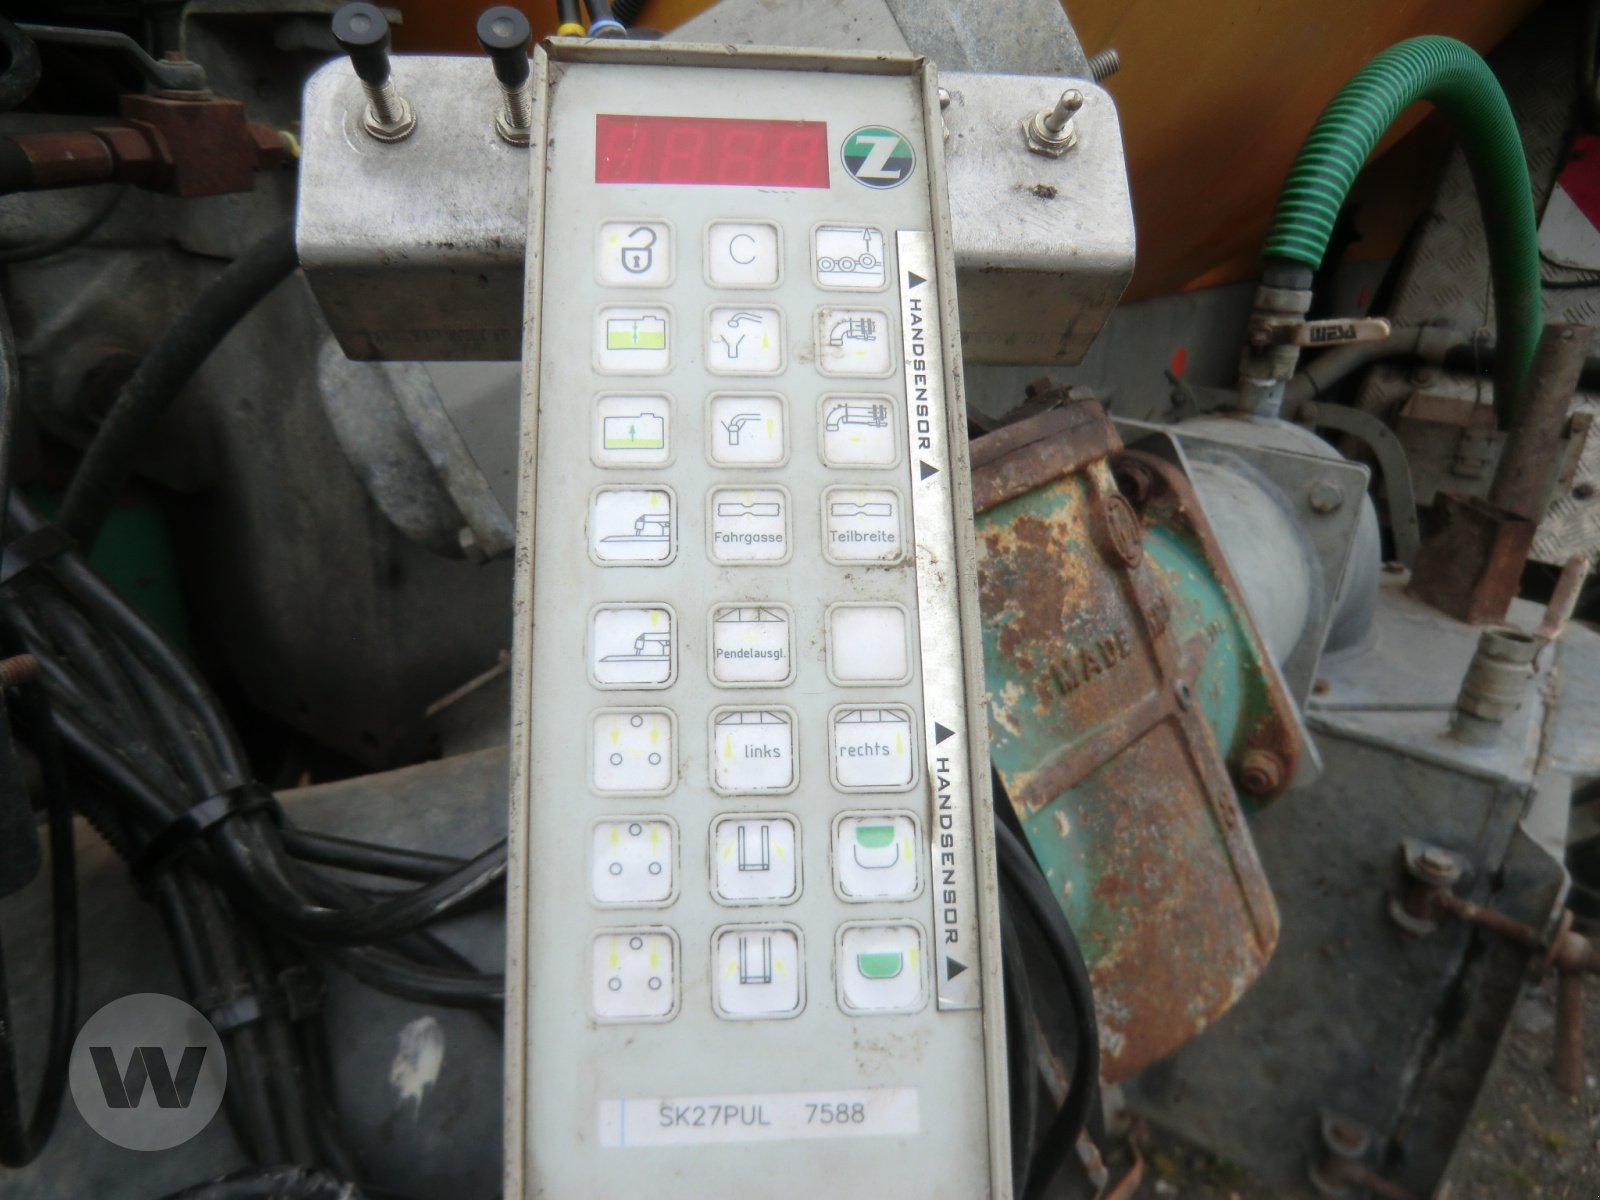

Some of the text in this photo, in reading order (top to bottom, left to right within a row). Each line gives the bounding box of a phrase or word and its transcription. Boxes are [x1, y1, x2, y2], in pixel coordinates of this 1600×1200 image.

[729, 233, 756, 265] C
[909, 298, 931, 450] HANDSENSOR
[714, 531, 783, 545] Fahrgasse
[830, 530, 895, 543] Teilbreite
[716, 648, 787, 660] Pendelausgl.
[745, 744, 781, 758] links
[840, 742, 890, 757] rechts
[936, 757, 959, 944] HANDSENSOR
[659, 1103, 866, 1127] SK27PUL 7588
